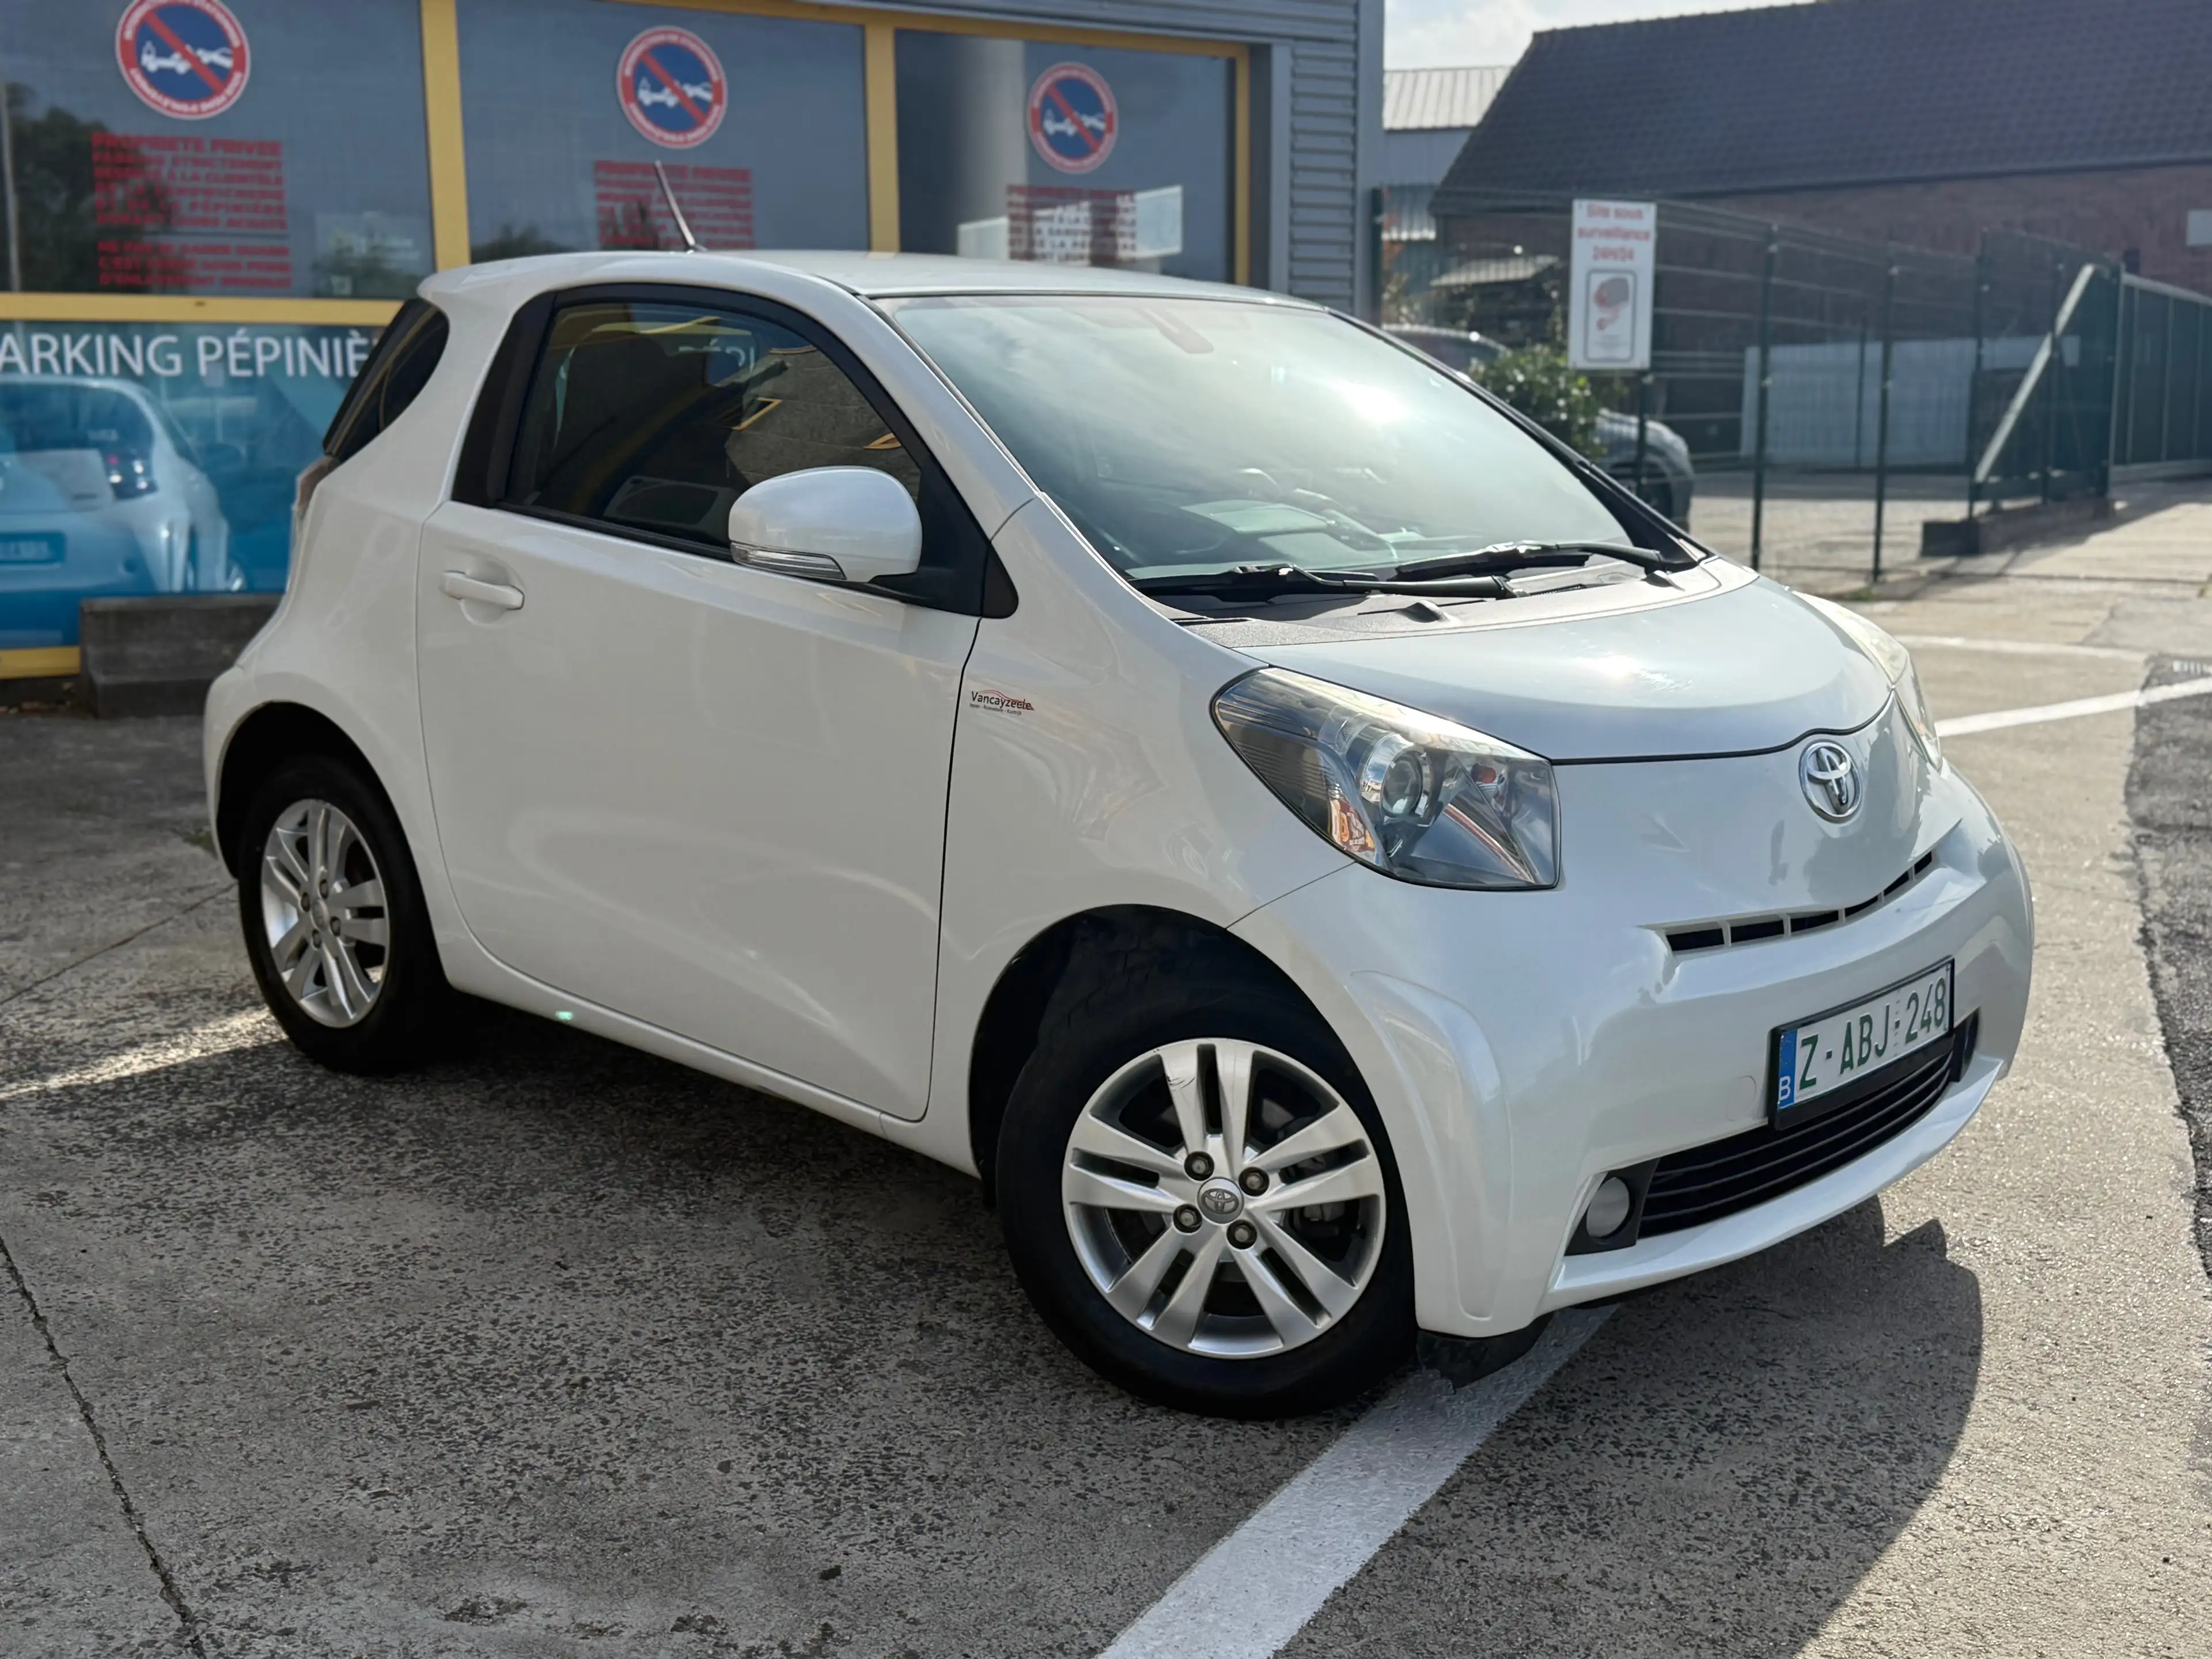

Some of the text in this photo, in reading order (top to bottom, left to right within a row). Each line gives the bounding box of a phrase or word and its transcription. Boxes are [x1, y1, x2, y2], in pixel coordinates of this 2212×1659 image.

[0, 327, 378, 378] ARKING PÉPINIÈ
[971, 691, 1032, 710] Vancayzeele
[1778, 1075, 1791, 1101] B
